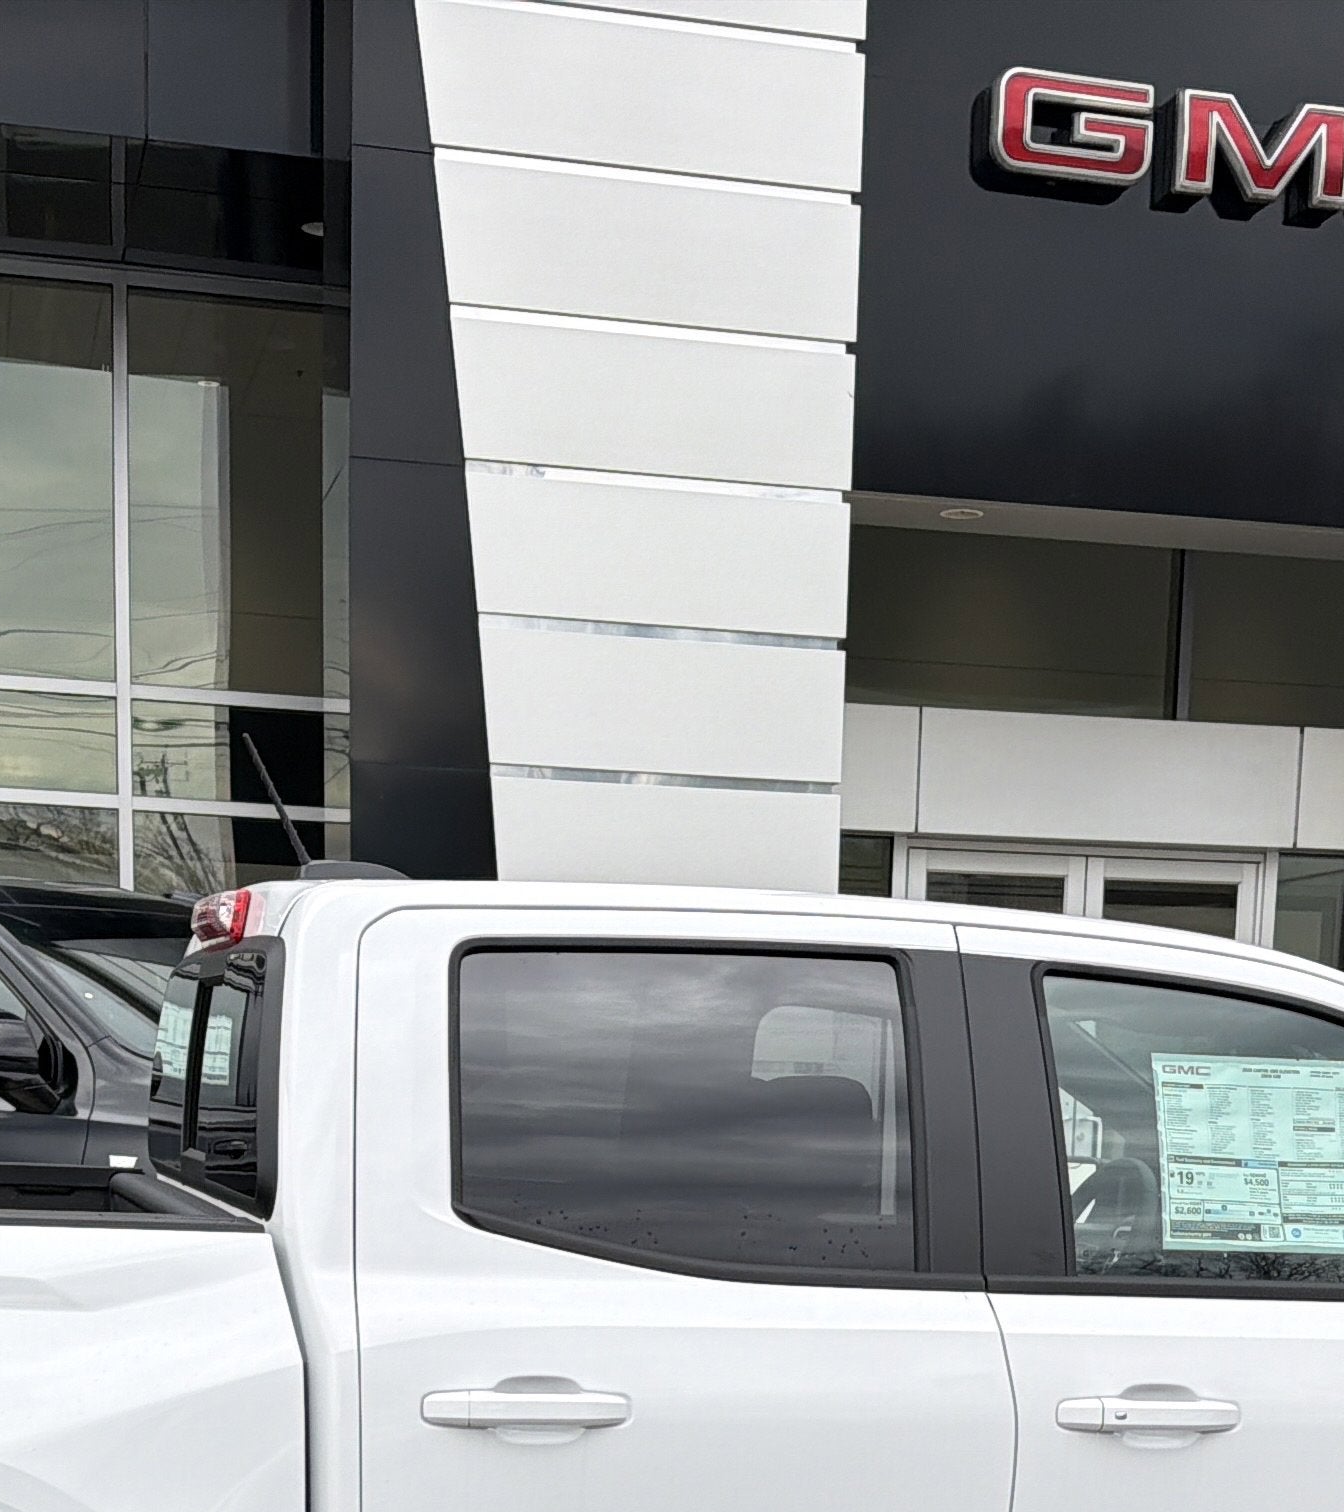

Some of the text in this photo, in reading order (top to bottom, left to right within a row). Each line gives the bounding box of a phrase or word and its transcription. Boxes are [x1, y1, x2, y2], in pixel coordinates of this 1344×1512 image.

[1161, 1063, 1212, 1077] GMC
[1176, 1170, 1195, 1186] 19
[1243, 1177, 1270, 1188] $4,500
[1174, 1206, 1203, 1216] $2,600
